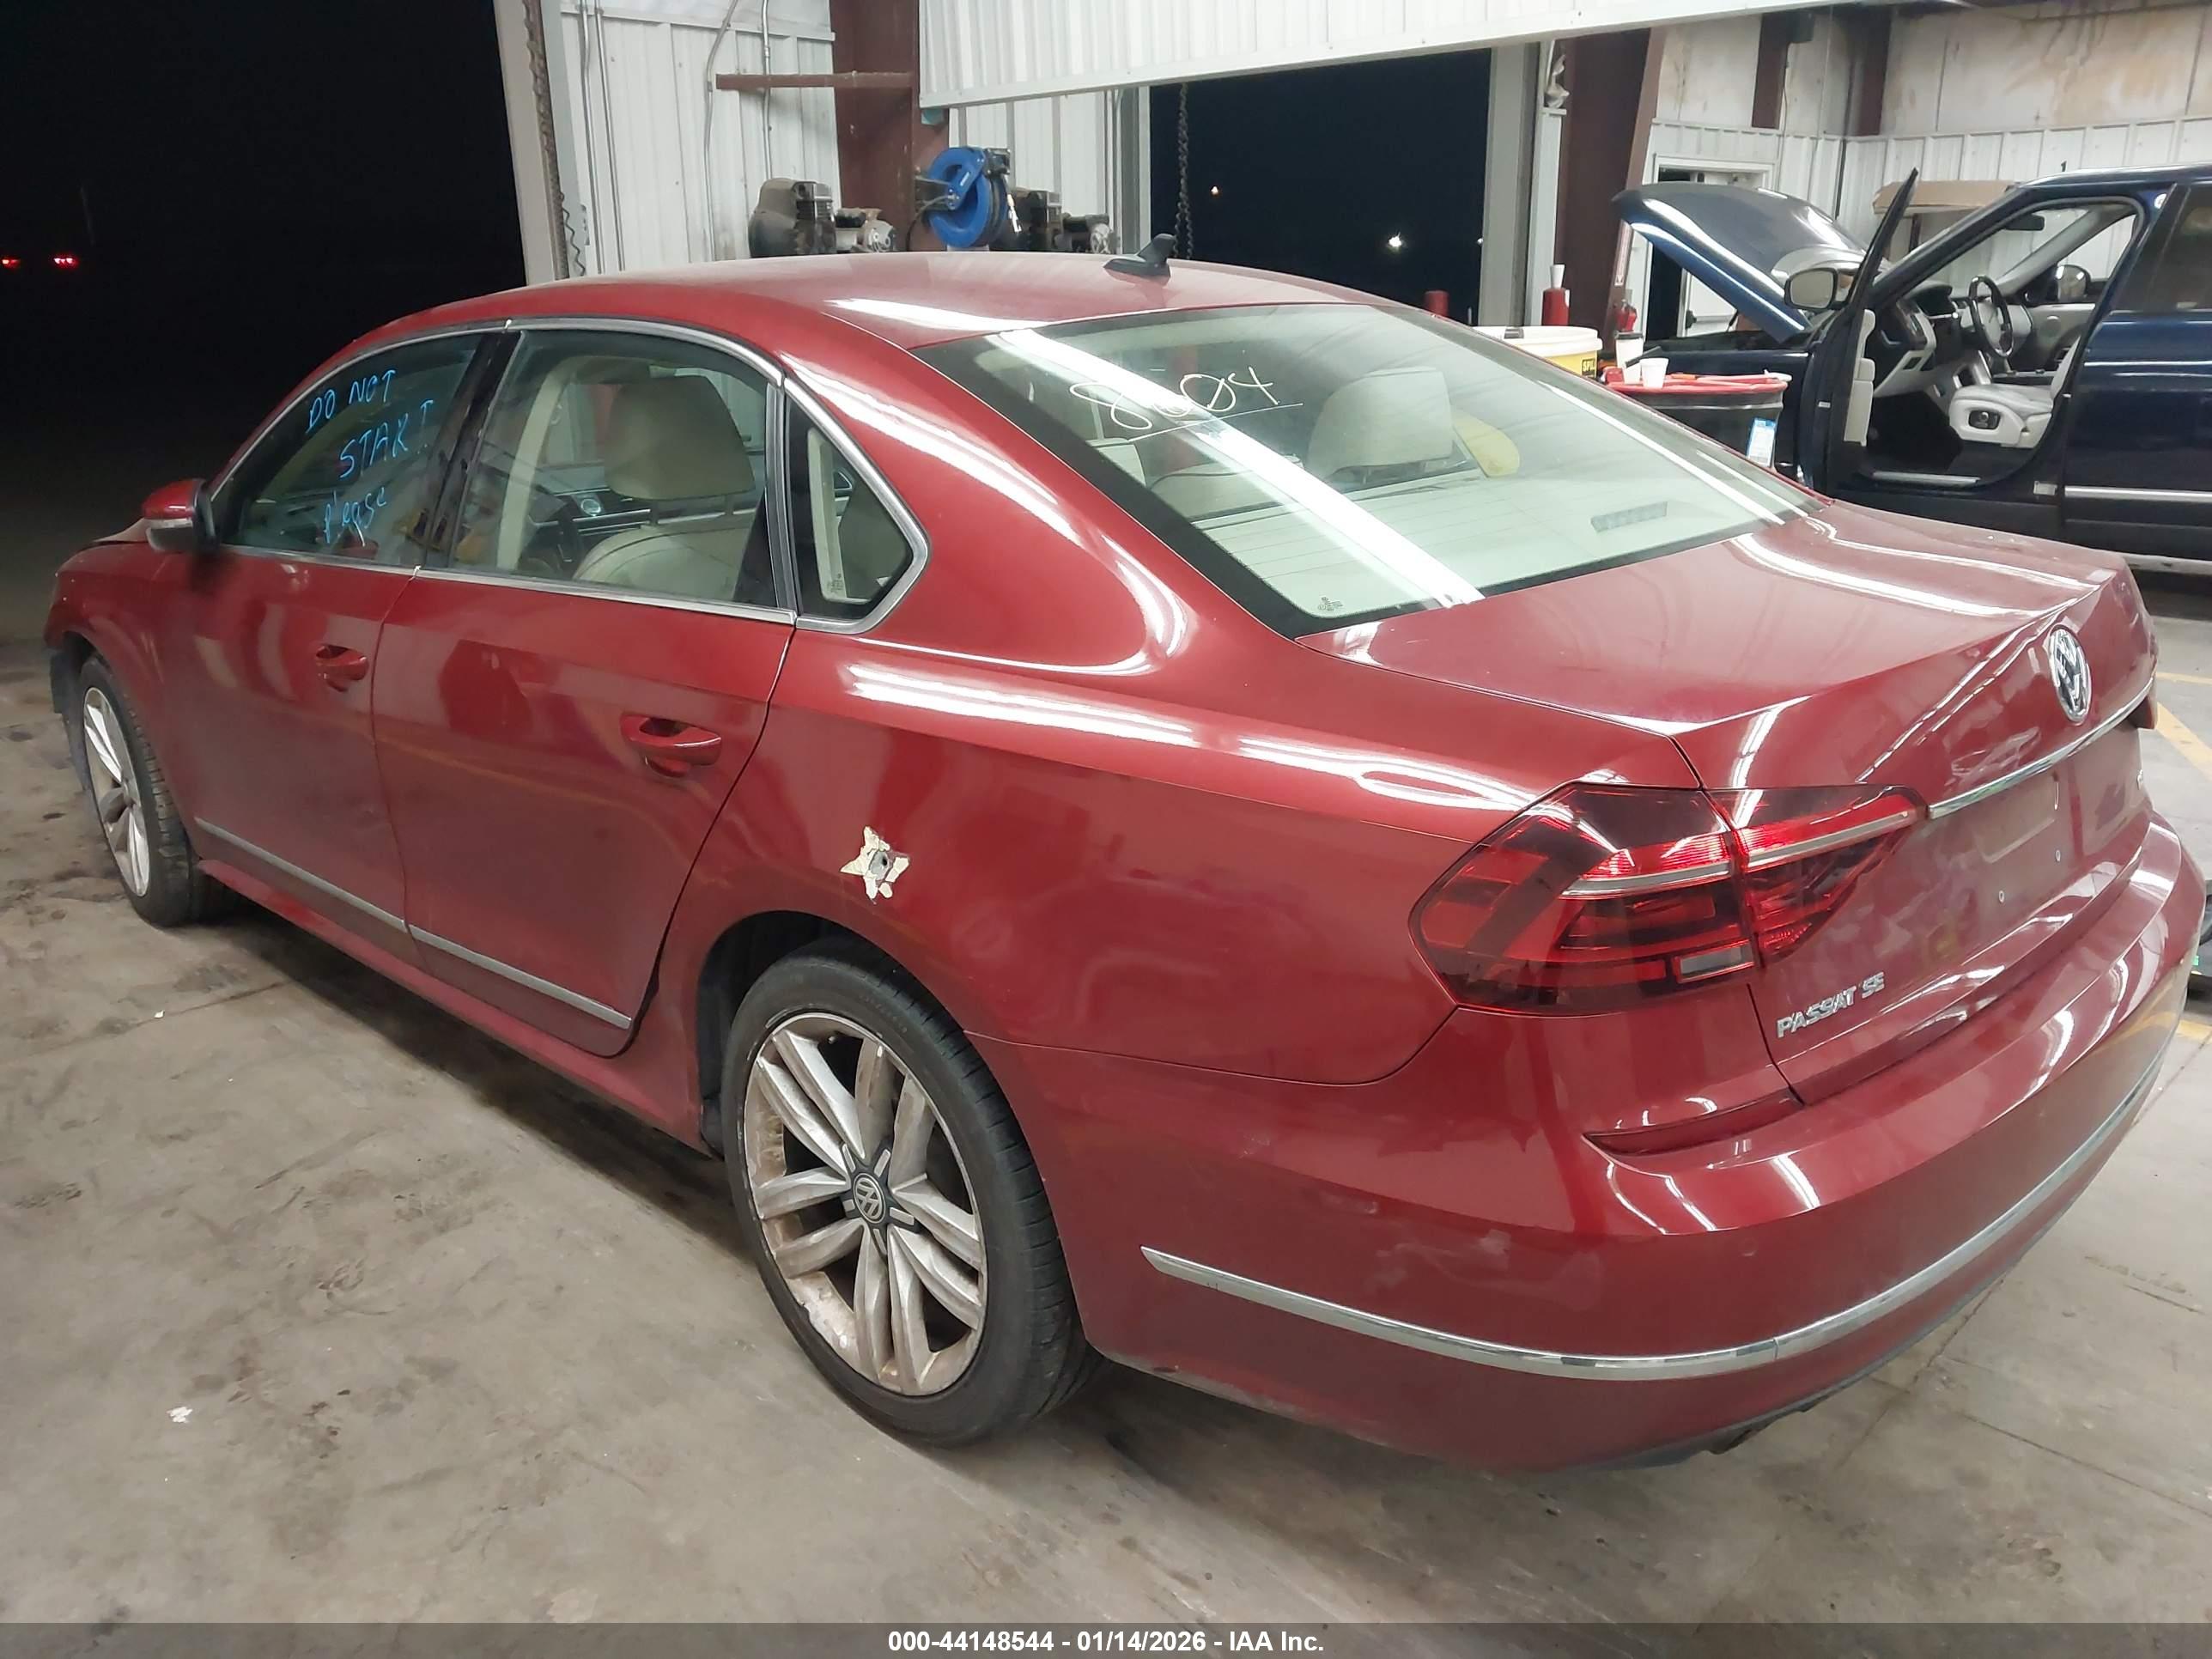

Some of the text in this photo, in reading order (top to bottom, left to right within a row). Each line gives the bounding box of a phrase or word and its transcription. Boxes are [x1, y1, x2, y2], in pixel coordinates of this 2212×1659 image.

[305, 369, 397, 434] DO NOT
[339, 398, 434, 478] START
[1776, 971, 1885, 1038] PASSAT SE
